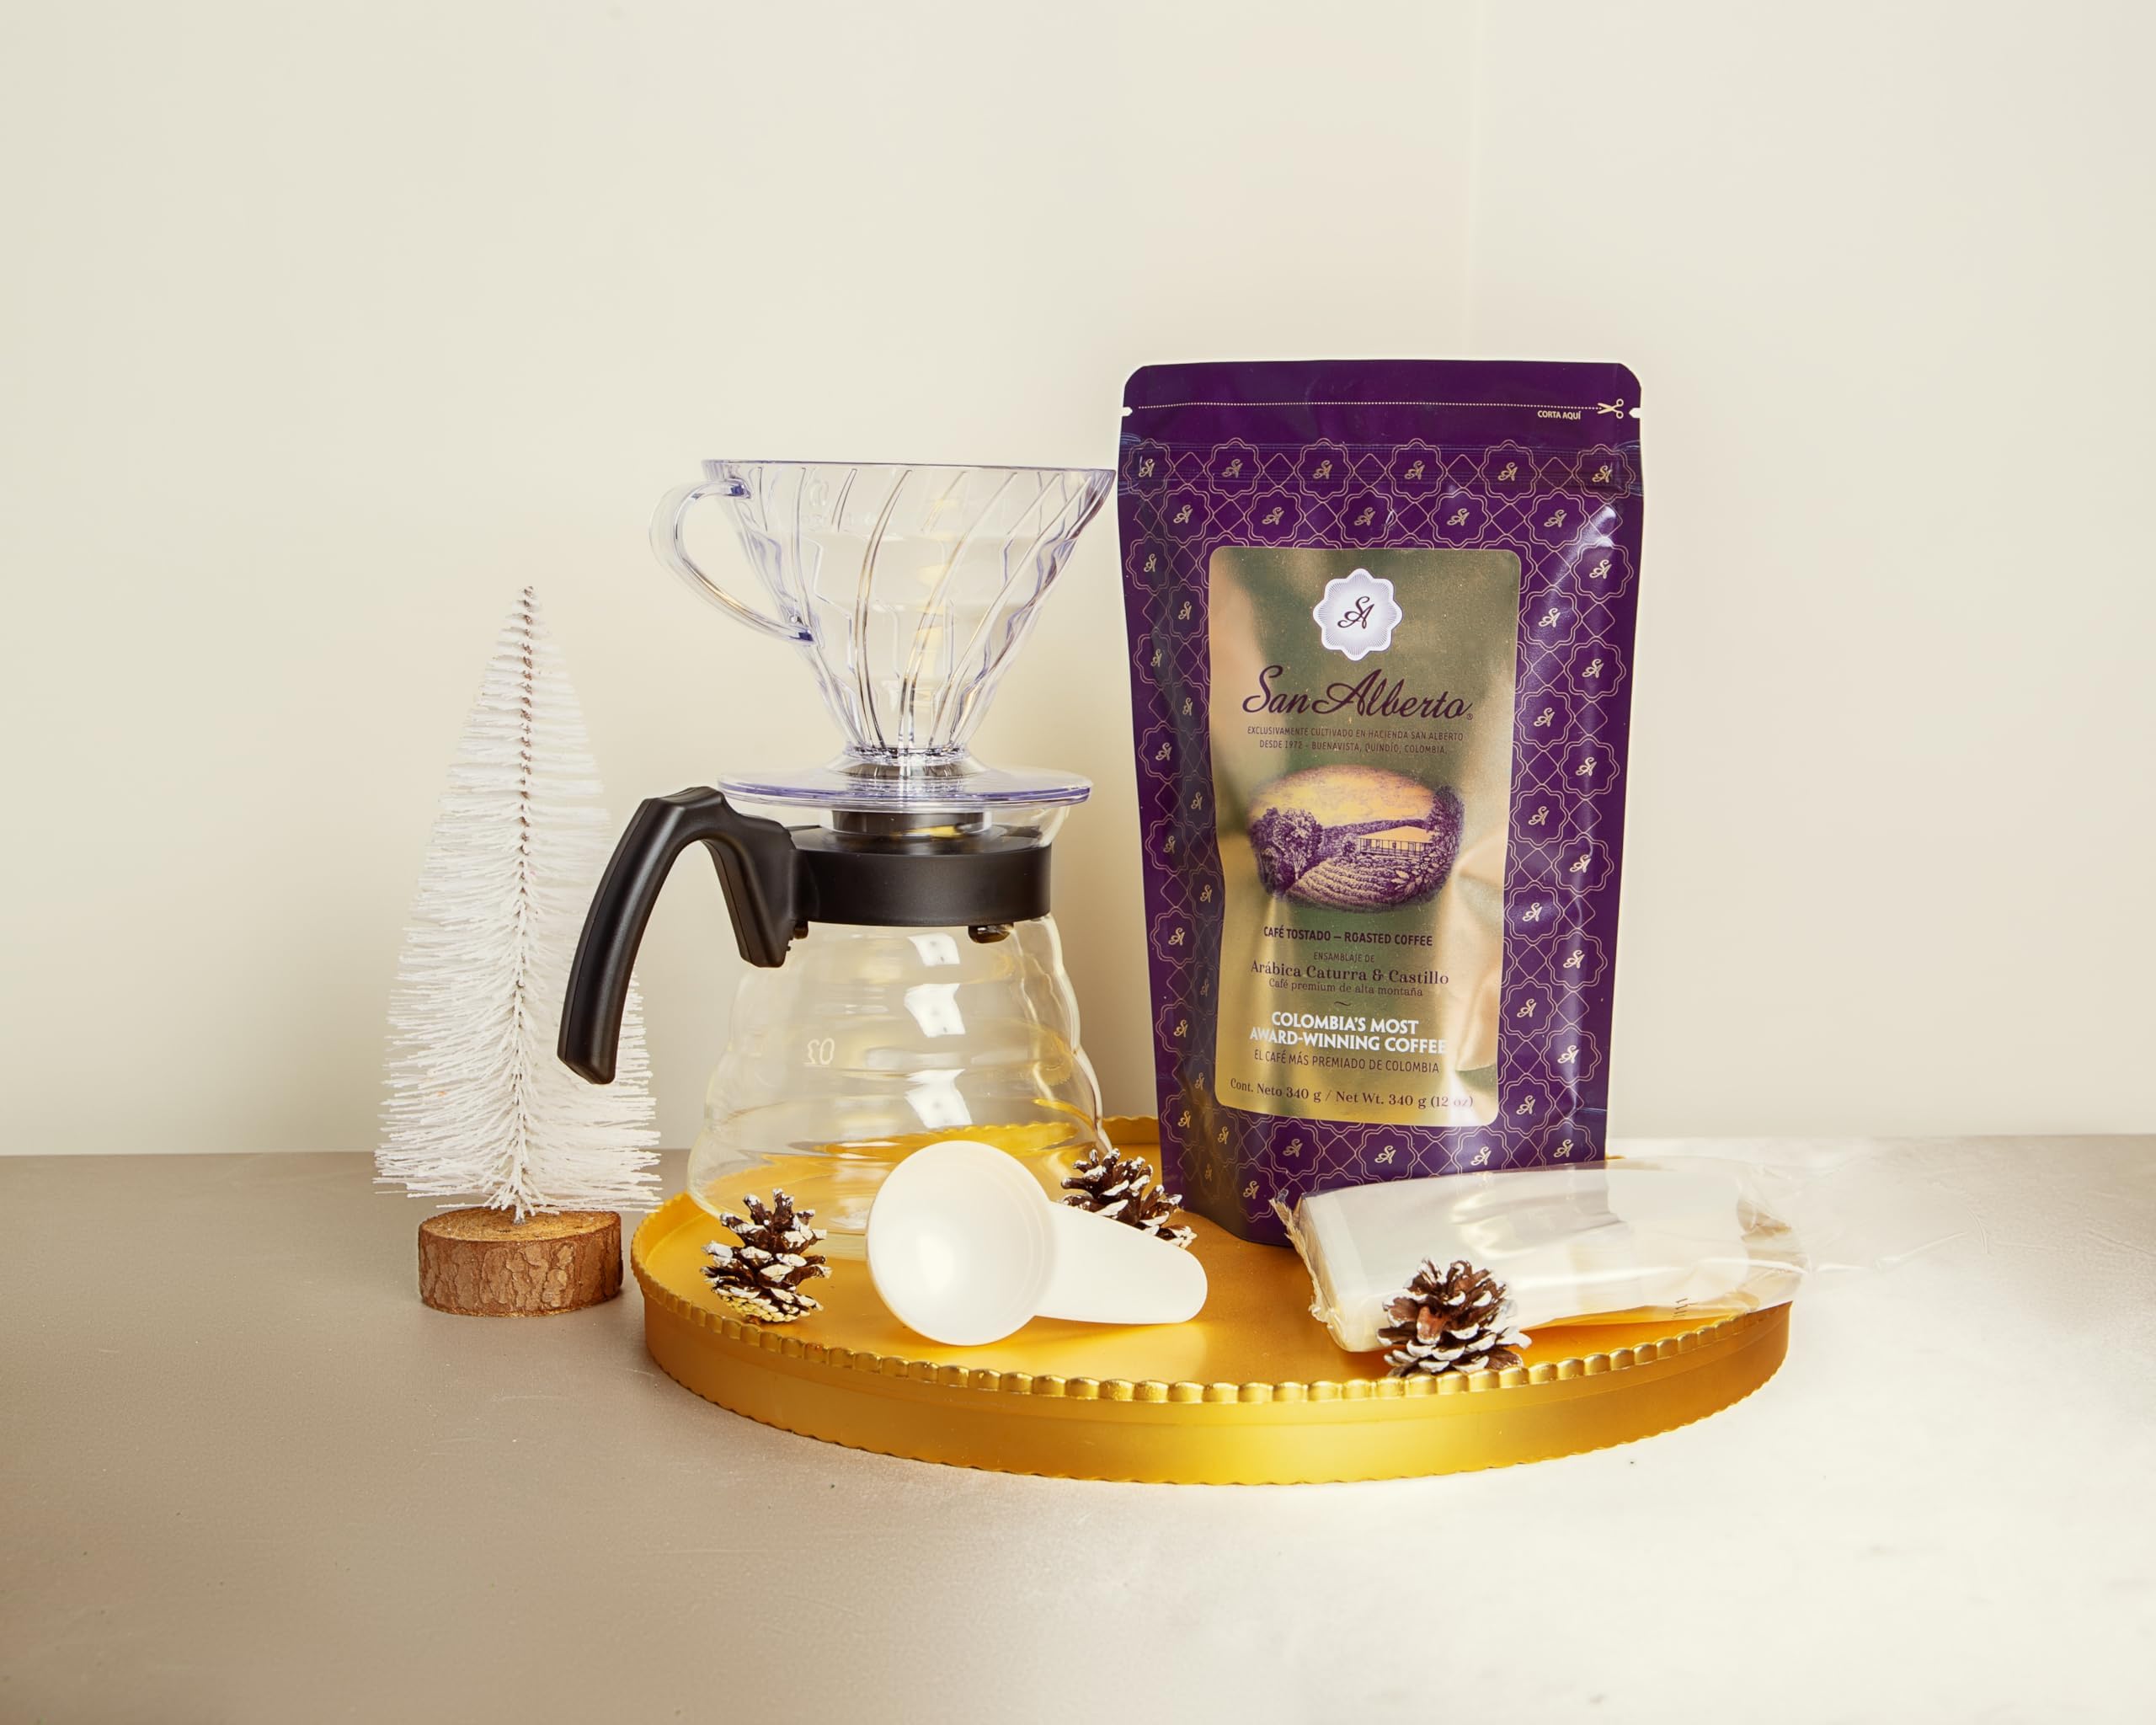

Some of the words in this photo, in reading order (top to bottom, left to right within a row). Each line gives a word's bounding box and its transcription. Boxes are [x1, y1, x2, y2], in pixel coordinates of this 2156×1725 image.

[1538, 410, 1561, 419] CORTA
[1562, 411, 1581, 420] AQUÍ
[1242, 665, 1310, 714] San
[1247, 725, 1309, 736] EXCLUSIVAMENTE
[1310, 728, 1353, 738] CULTIVADO
[1356, 729, 1366, 739] EN
[1368, 729, 1410, 740] HACIENDA
[1411, 731, 1427, 740] SAN
[1428, 732, 1464, 742] ALBERTO
[1259, 740, 1283, 749] DESDE
[1284, 740, 1303, 750] 1972
[1311, 741, 1362, 752] BUENAVISTA,
[1364, 741, 1401, 754] QUINDÍO,
[1404, 745, 1448, 755] COLOMBIA.
[1263, 925, 1284, 938] CAFÉ
[1287, 928, 1331, 942] TOSTADO
[1344, 932, 1391, 944] ROASTED
[1395, 934, 1433, 947] COFFEE
[1314, 951, 1363, 963] ENSAMBLAJE
[1364, 954, 1375, 963] DE
[1251, 960, 1301, 977] Arábica
[1306, 965, 1367, 981] Caturra
[1372, 969, 1385, 981] &
[1390, 969, 1449, 985] Castillo
[1269, 978, 1289, 989] Café
[1291, 982, 1336, 992] premium
[1339, 982, 1352, 993] de
[1355, 983, 1374, 994] alta
[1378, 986, 1423, 996] montaña
[1272, 1011, 1366, 1033] COLOMBIA'S
[1370, 1018, 1419, 1035] MOST
[1249, 1027, 1380, 1051] AWARD-WINNING
[1385, 1038, 1448, 1054] COFFEE
[1254, 1049, 1264, 1061] EL
[1265, 1049, 1286, 1064] CAFÉ
[1289, 1051, 1309, 1065] MÁS
[1312, 1056, 1366, 1070] PREMIADO
[1369, 1060, 1382, 1071] DE
[1385, 1060, 1439, 1073] COLOMBIA
[1230, 1078, 1254, 1092] Cont.
[1257, 1083, 1283, 1097] Neto
[1286, 1087, 1310, 1099] 340
[1314, 1091, 1321, 1103] g
[1336, 1091, 1358, 1103] Net
[1363, 1092, 1384, 1105] Wt.
[1389, 1095, 1413, 1106] 340
[1417, 1097, 1427, 1108] g
[1431, 1096, 1449, 1108] (12
[1454, 1096, 1474, 1108] oz)
